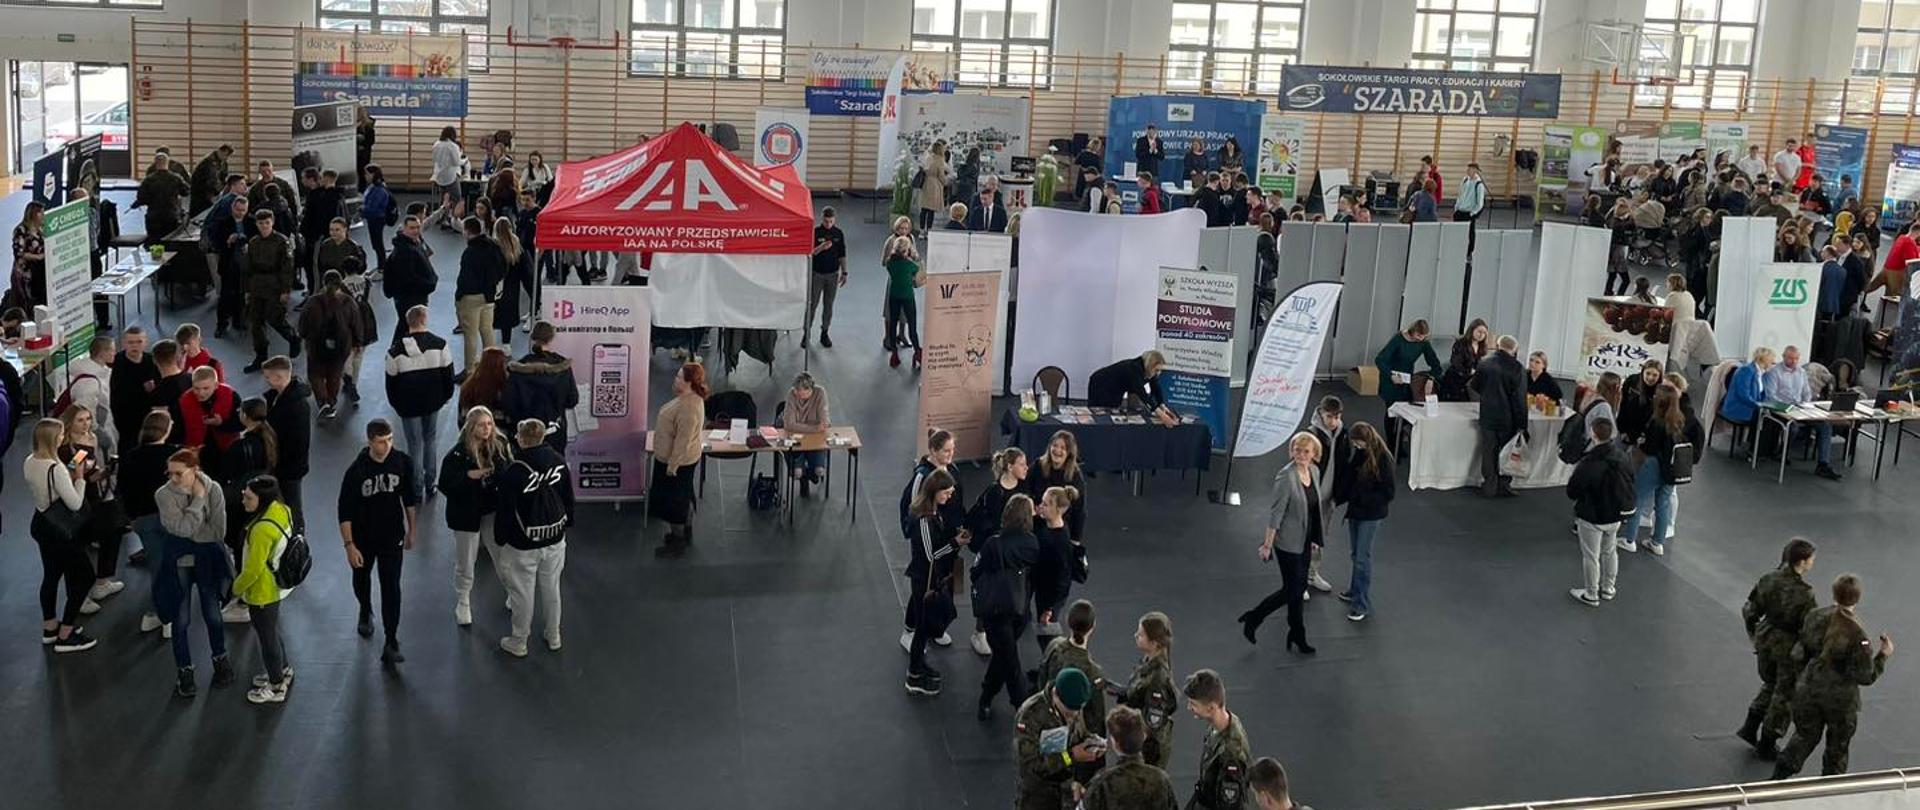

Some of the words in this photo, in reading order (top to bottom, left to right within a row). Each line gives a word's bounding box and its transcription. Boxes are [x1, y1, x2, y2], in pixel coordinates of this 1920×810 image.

[1318, 73, 1381, 83] SOKOŁOWSKIE
[1384, 75, 1409, 84] TARGI
[1411, 76, 1441, 86] PRACY,
[1442, 77, 1484, 87] EDUKACJI
[1489, 79, 1527, 88] KARIERY
[560, 225, 674, 238] AUTORYZOWANY
[677, 226, 789, 239] PRZEDSTAWICIEL
[623, 238, 646, 248] IAA
[650, 239, 668, 248] NA
[671, 239, 725, 252] POLSKĘ
[1768, 279, 1808, 305] ZUS
[580, 306, 610, 316] HireQ
[610, 306, 630, 316] App
[1179, 305, 1212, 316] STUDIA
[1158, 314, 1232, 331] PODYPLOMOWE
